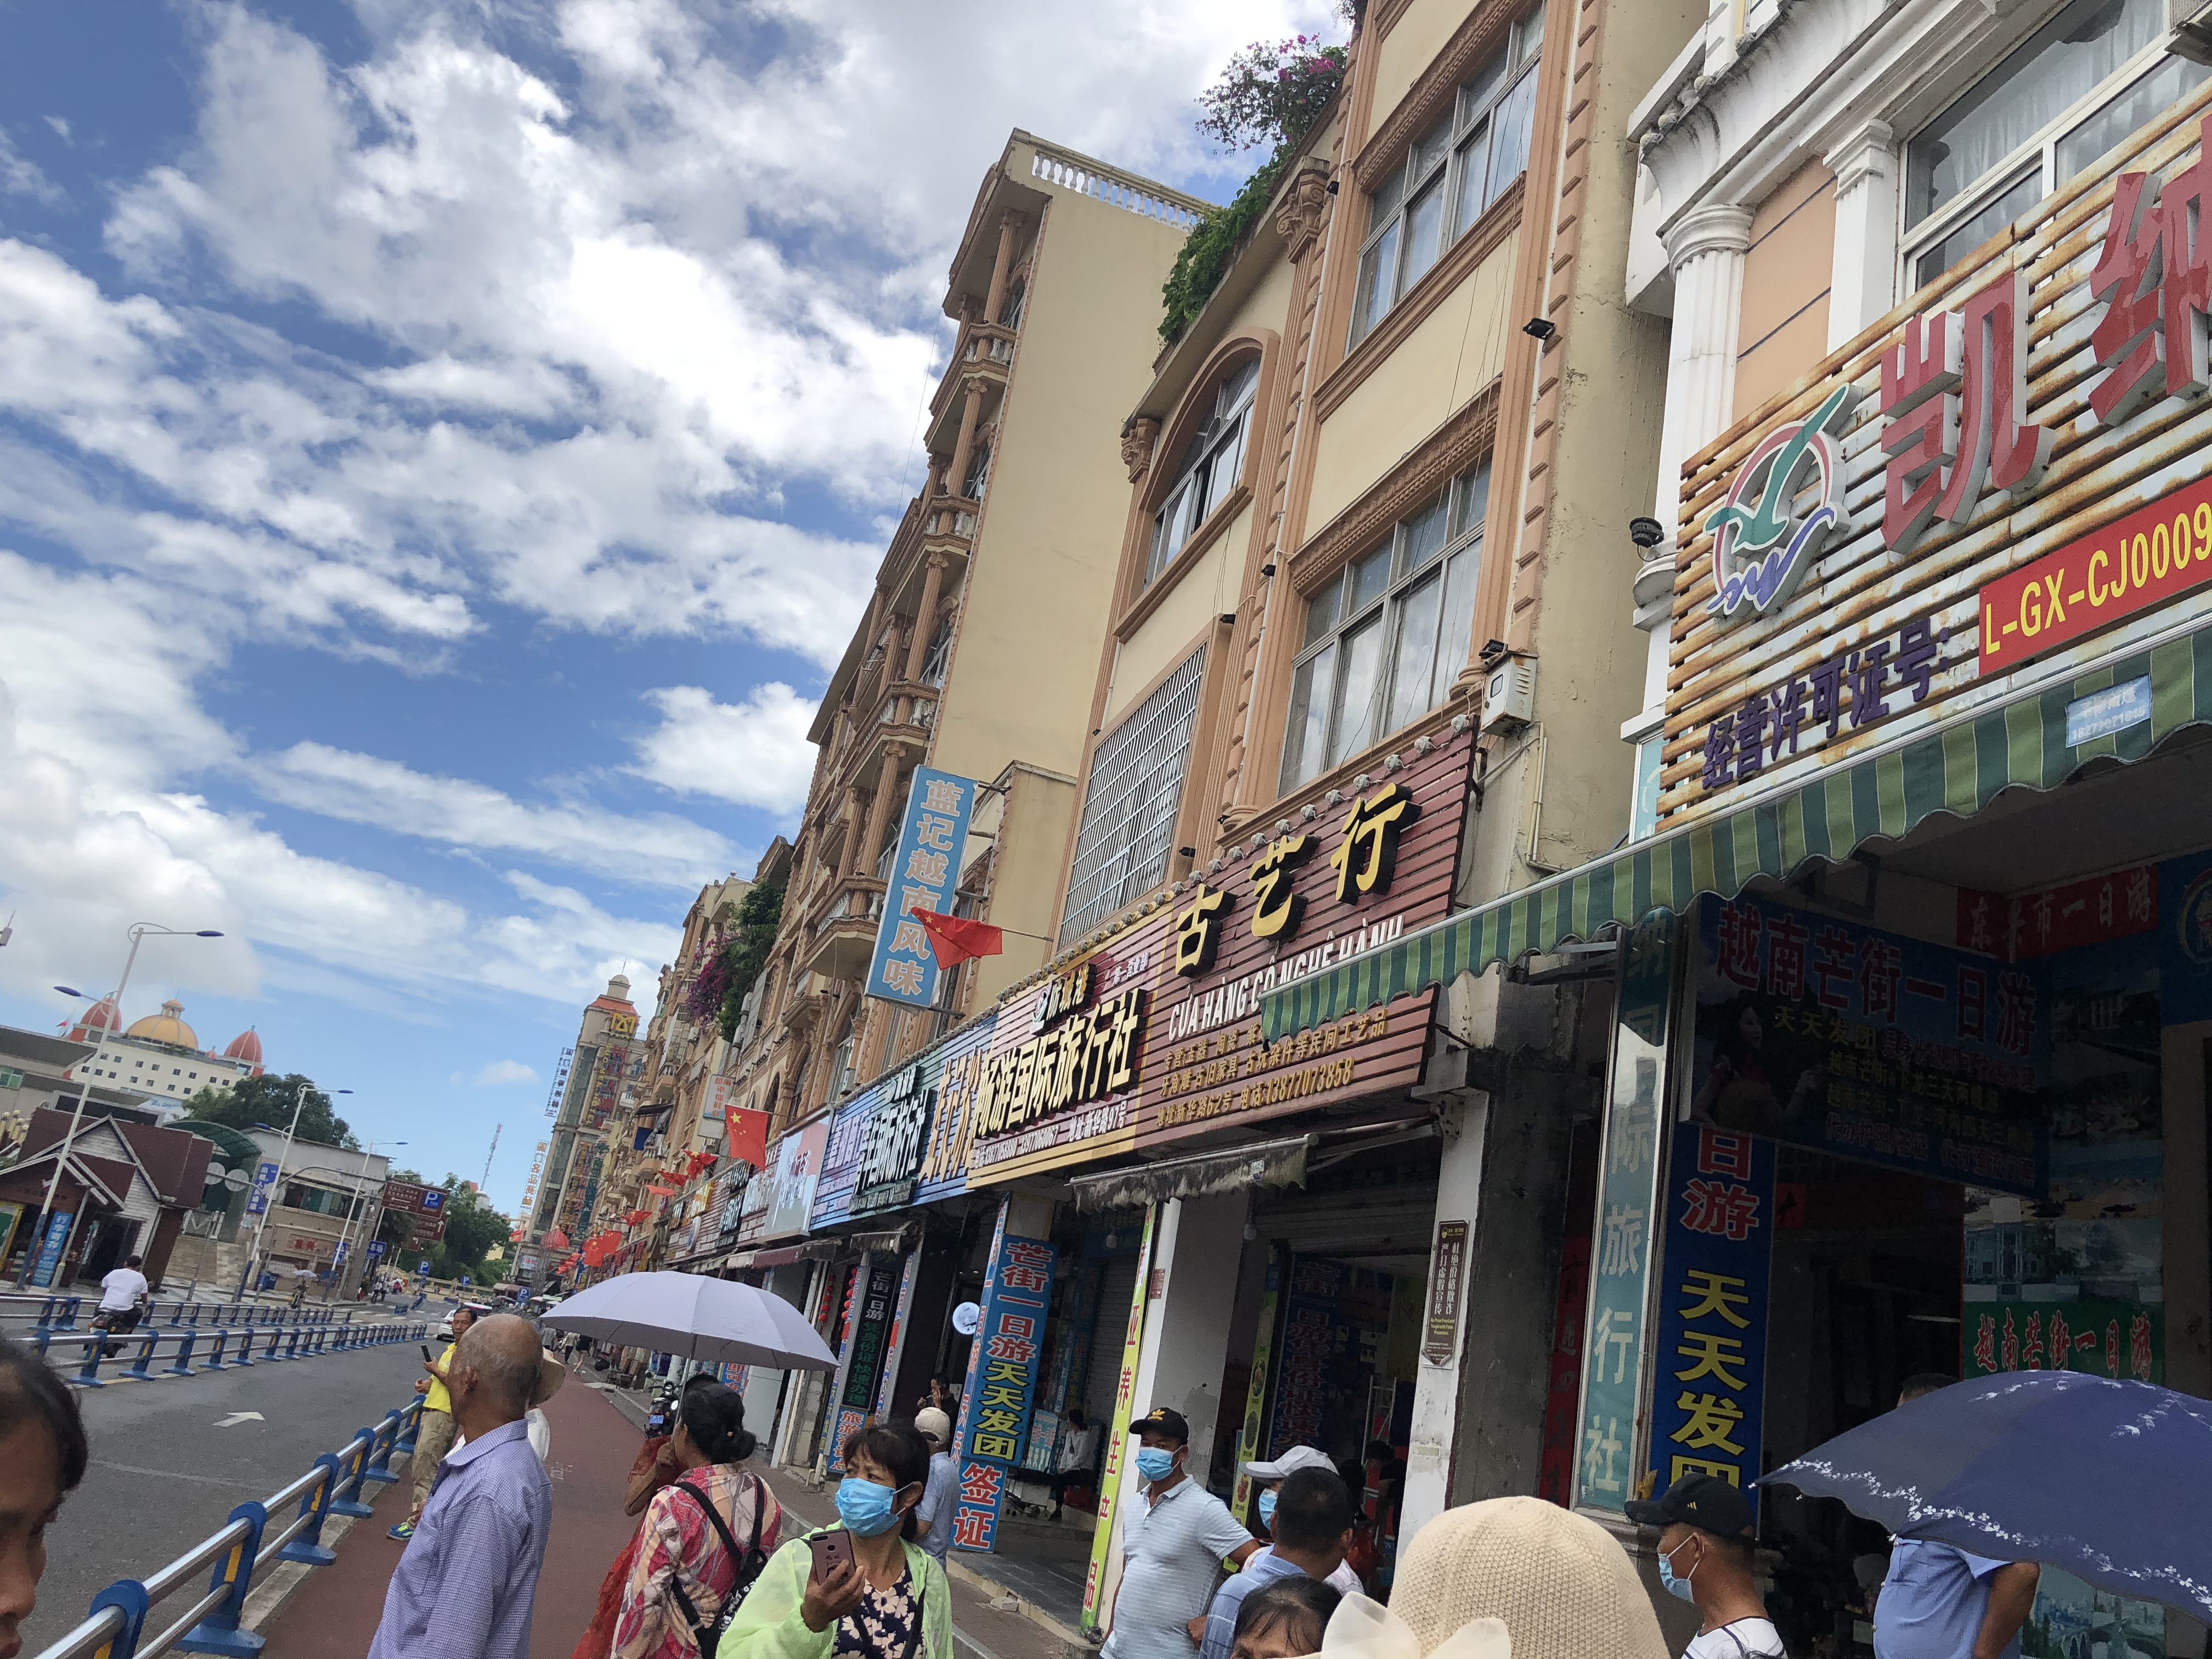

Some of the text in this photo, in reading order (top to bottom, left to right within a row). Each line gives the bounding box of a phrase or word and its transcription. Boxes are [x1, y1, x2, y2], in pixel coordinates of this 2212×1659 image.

[1175, 783, 1413, 975] 古艺行
[1201, 976, 1250, 1029] HÀNG
[1716, 900, 2037, 1057] 越南芒街一日游
[972, 988, 1139, 1139] 畅游国际旅行社
[1974, 1307, 2153, 1383] 越南芒街一日游
[954, 1462, 1001, 1550] 签证
